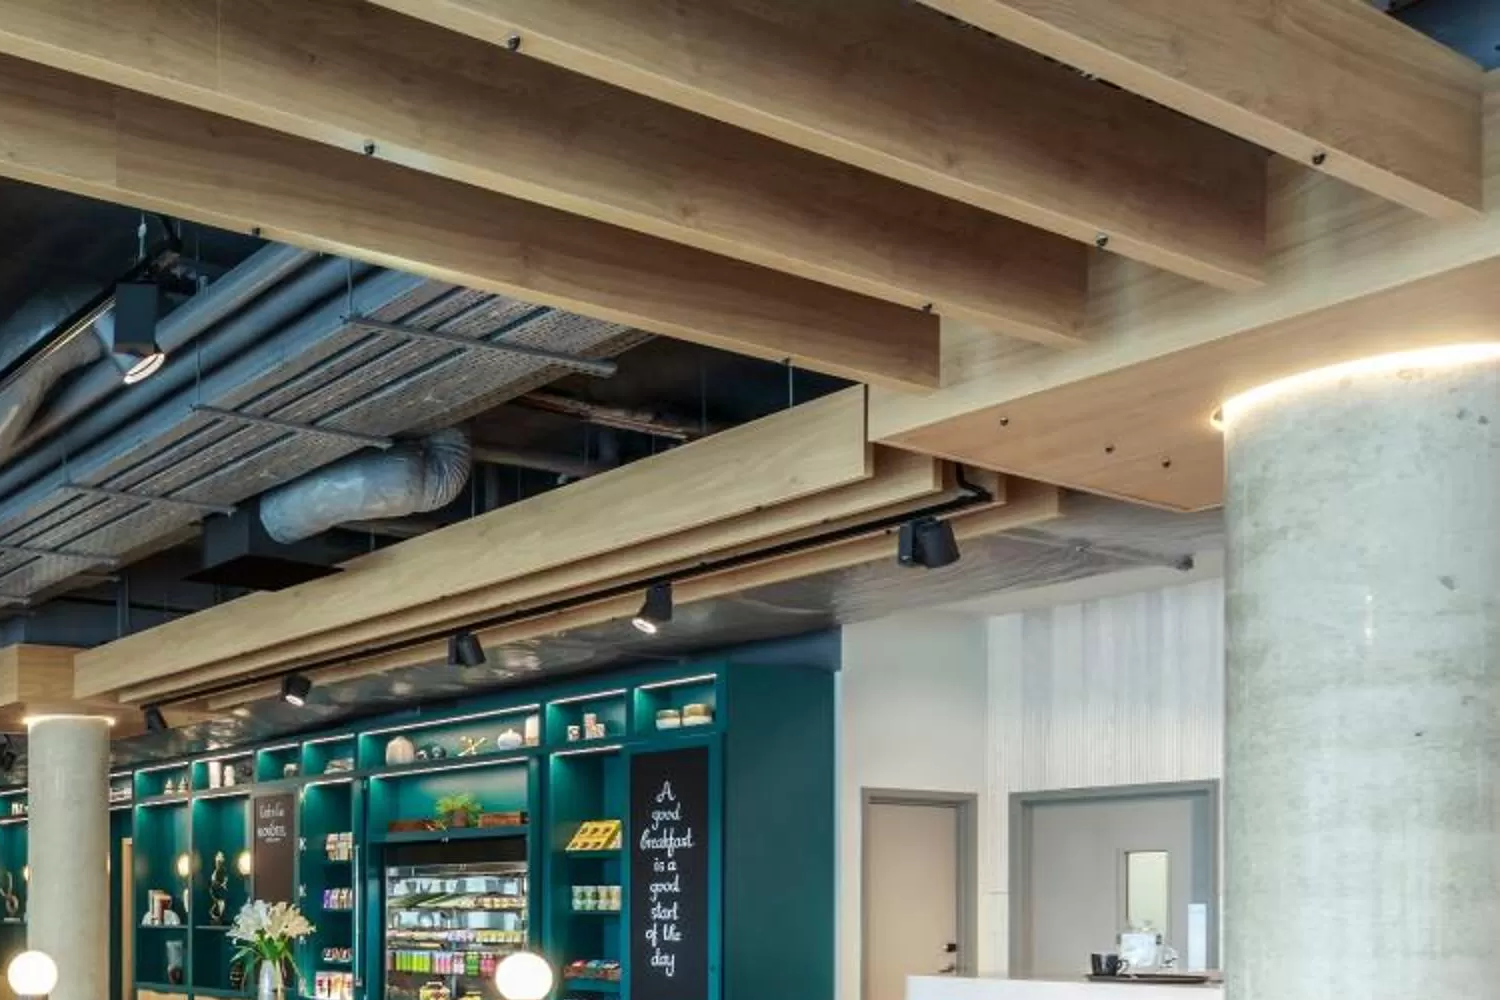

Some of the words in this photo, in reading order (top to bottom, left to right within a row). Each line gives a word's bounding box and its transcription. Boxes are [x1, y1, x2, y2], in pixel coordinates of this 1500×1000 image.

[655, 781, 675, 802] A
[651, 801, 681, 830] good
[640, 827, 693, 857] breakfast
[653, 858, 665, 872] is
[667, 861, 677, 871] a
[649, 873, 681, 902] good
[651, 902, 679, 920] start
[645, 923, 658, 947] of
[662, 925, 682, 942] the
[651, 948, 676, 977] day
